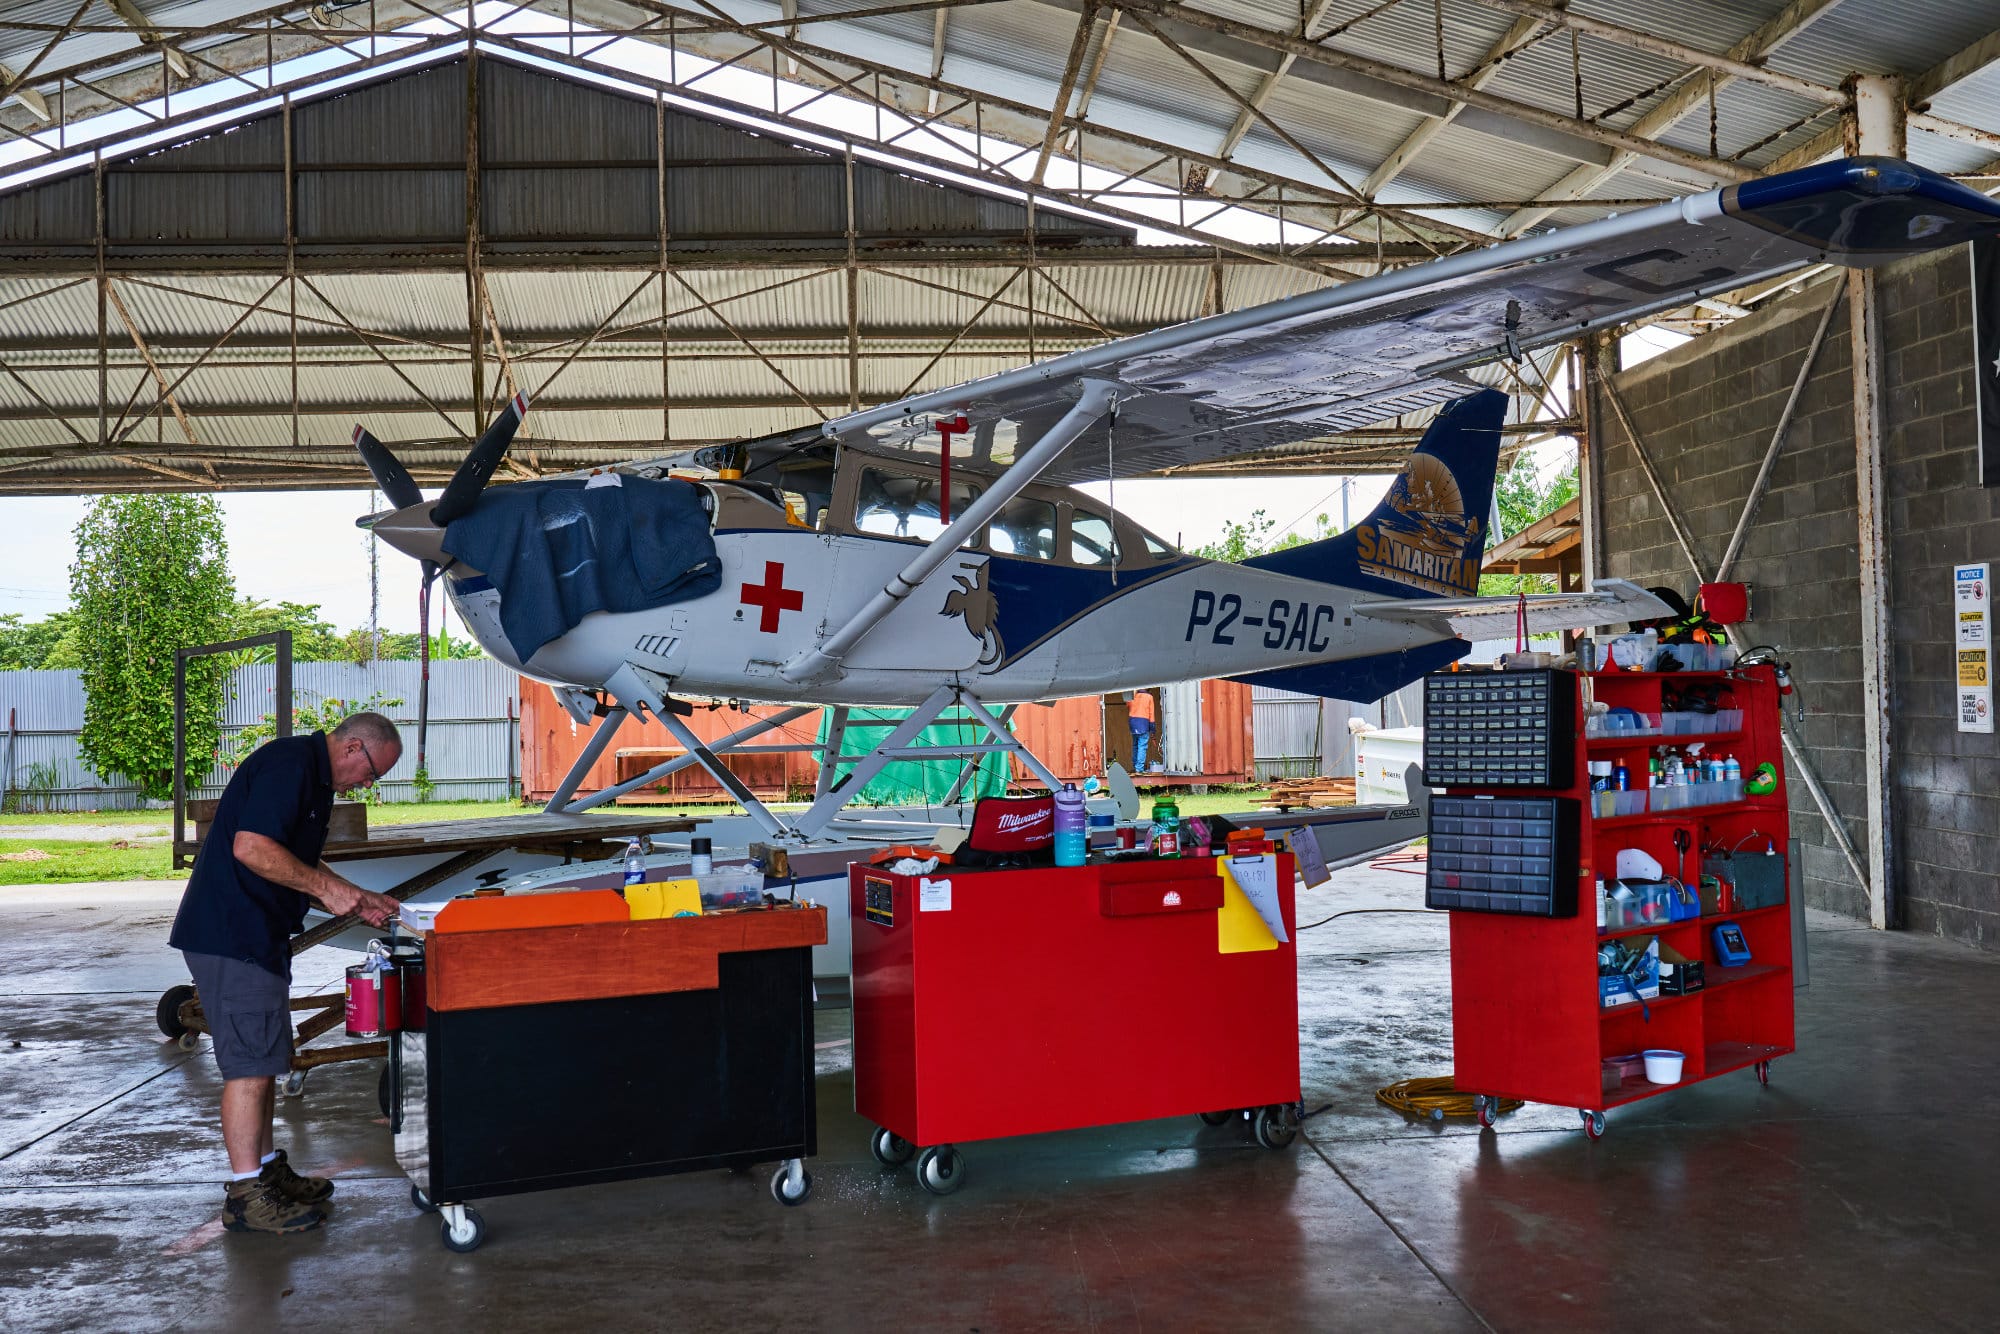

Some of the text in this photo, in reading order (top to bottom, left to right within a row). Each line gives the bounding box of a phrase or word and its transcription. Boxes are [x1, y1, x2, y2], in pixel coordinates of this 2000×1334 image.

[1357, 525, 1479, 593] SAMARITAN
[1380, 567, 1457, 597] AVIATION
[1960, 570, 1980, 579] NOTICE
[1185, 589, 1335, 653] P2-SAC
[1960, 652, 1985, 662] CAUTION
[998, 808, 1051, 829] Milwaukee
